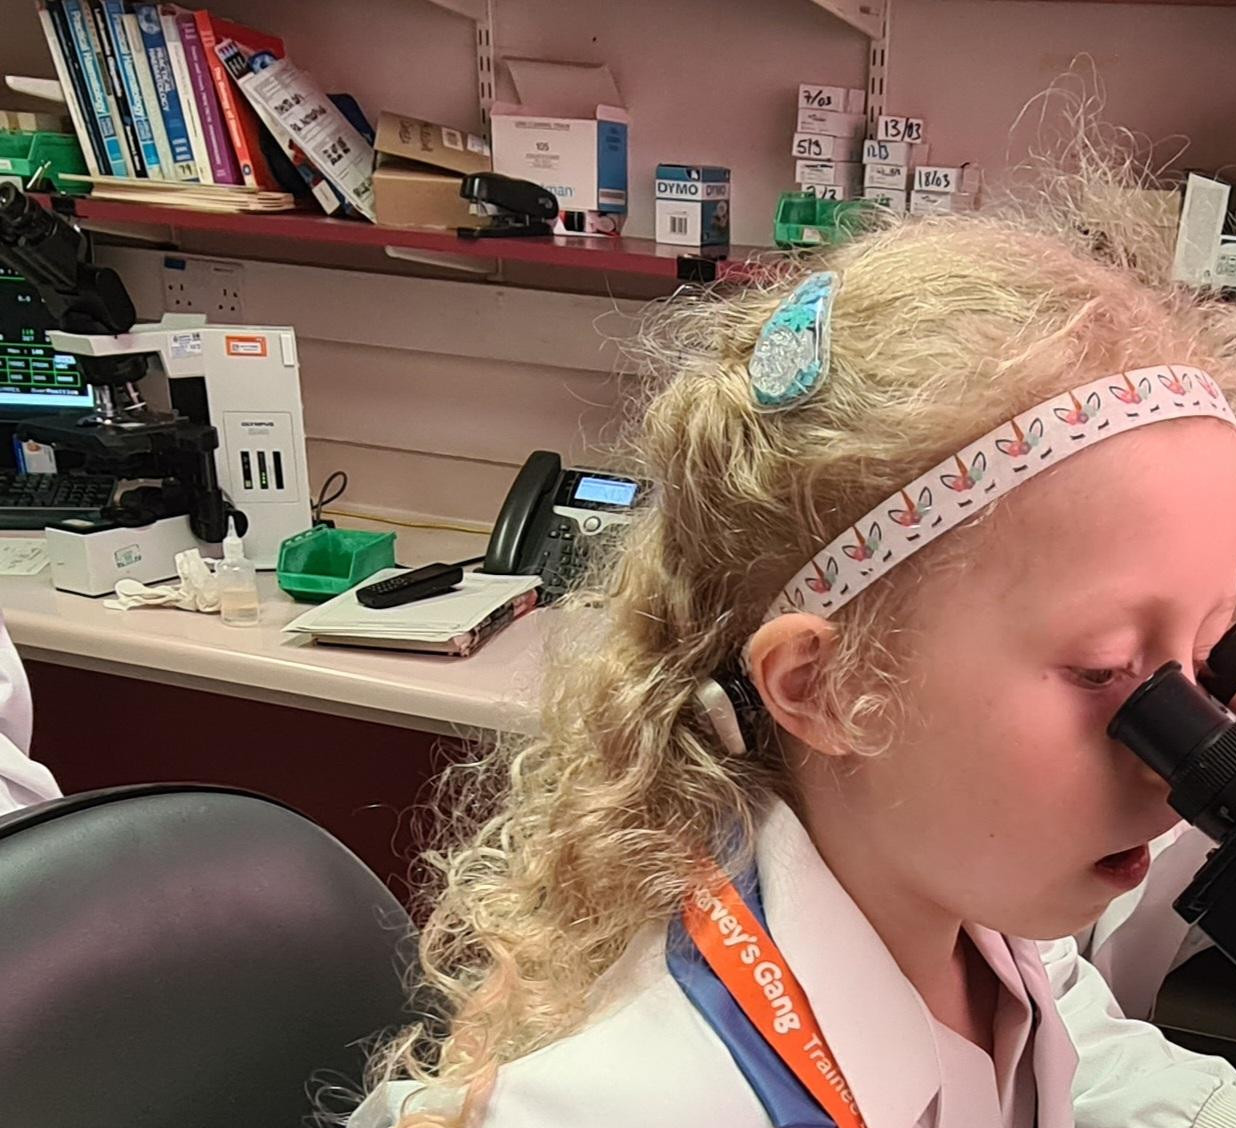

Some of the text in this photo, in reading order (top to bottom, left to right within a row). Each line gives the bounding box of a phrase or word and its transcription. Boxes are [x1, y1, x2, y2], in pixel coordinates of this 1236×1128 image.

[803, 90, 832, 107] 7/03
[918, 170, 950, 187] 18/03
[657, 182, 698, 196] DYMO
[754, 961, 800, 1035] Gang
